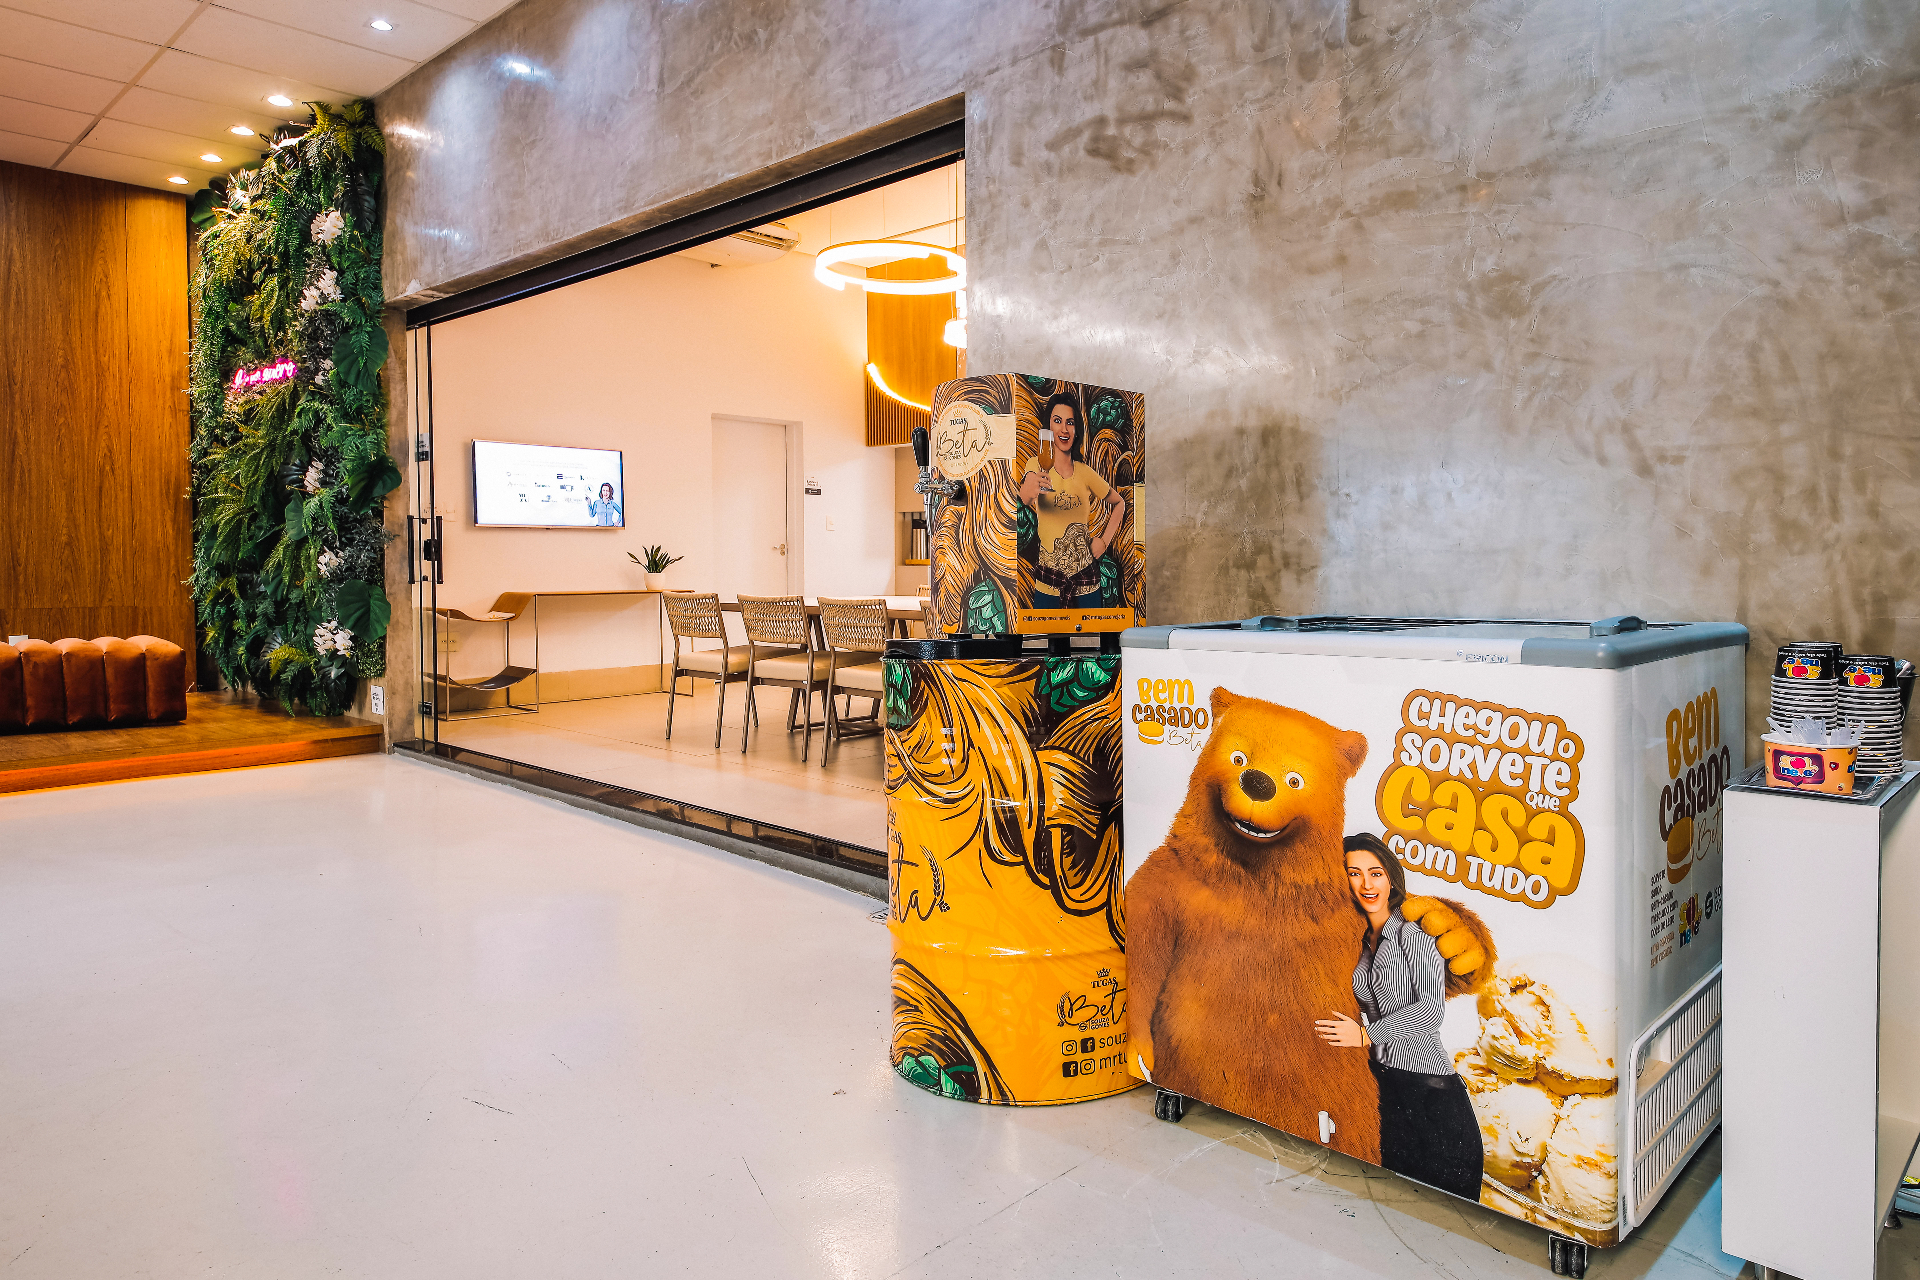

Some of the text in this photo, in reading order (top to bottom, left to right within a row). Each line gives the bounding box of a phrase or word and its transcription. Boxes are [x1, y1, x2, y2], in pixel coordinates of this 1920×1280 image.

[936, 421, 988, 458] Beta
[1166, 727, 1203, 752] Beta
[1090, 977, 1117, 989] TUGAS
